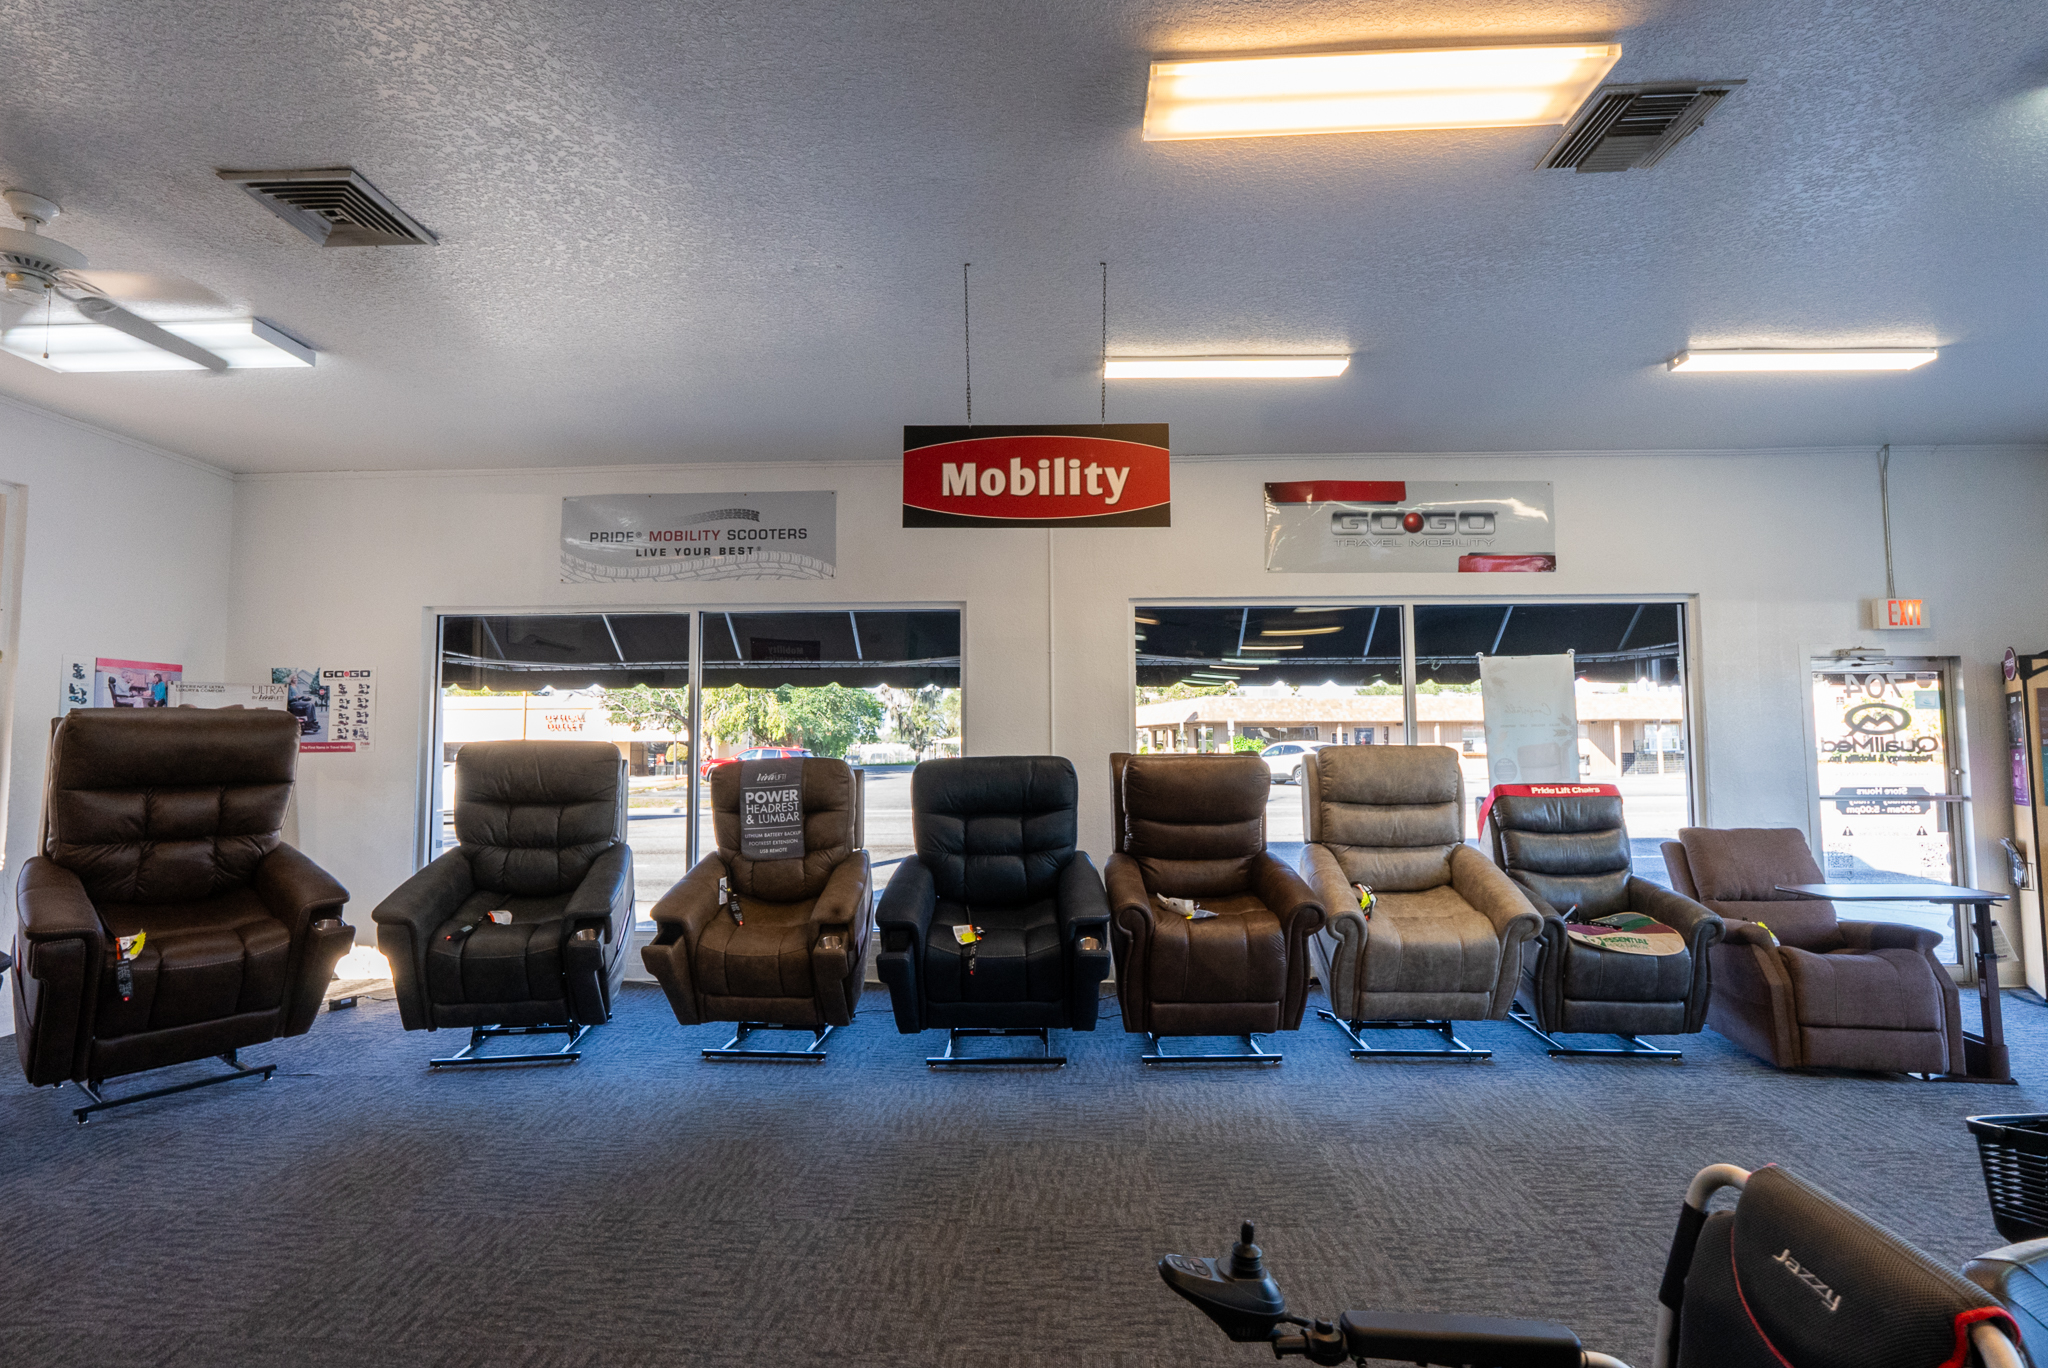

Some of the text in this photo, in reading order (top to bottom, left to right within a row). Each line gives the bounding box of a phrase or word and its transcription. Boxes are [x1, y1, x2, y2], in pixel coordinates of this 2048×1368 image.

[942, 457, 1131, 505] Mobility
[649, 530, 721, 542] MOBILITY
[727, 528, 808, 540] SCOOTERS
[1333, 538, 1496, 548] TRAVEL MOBILITY
[635, 547, 667, 557] LIVE
[674, 547, 712, 556] YOUR
[1888, 599, 1923, 626] EXIT
[252, 685, 285, 695] ULTRA
[745, 789, 799, 804] POWER
[1531, 786, 1600, 794] Pride Lift Chairs
[746, 801, 799, 814] HEADREST
[746, 812, 800, 825] & LUMBAR
[1772, 1248, 1842, 1312] Jazzy
